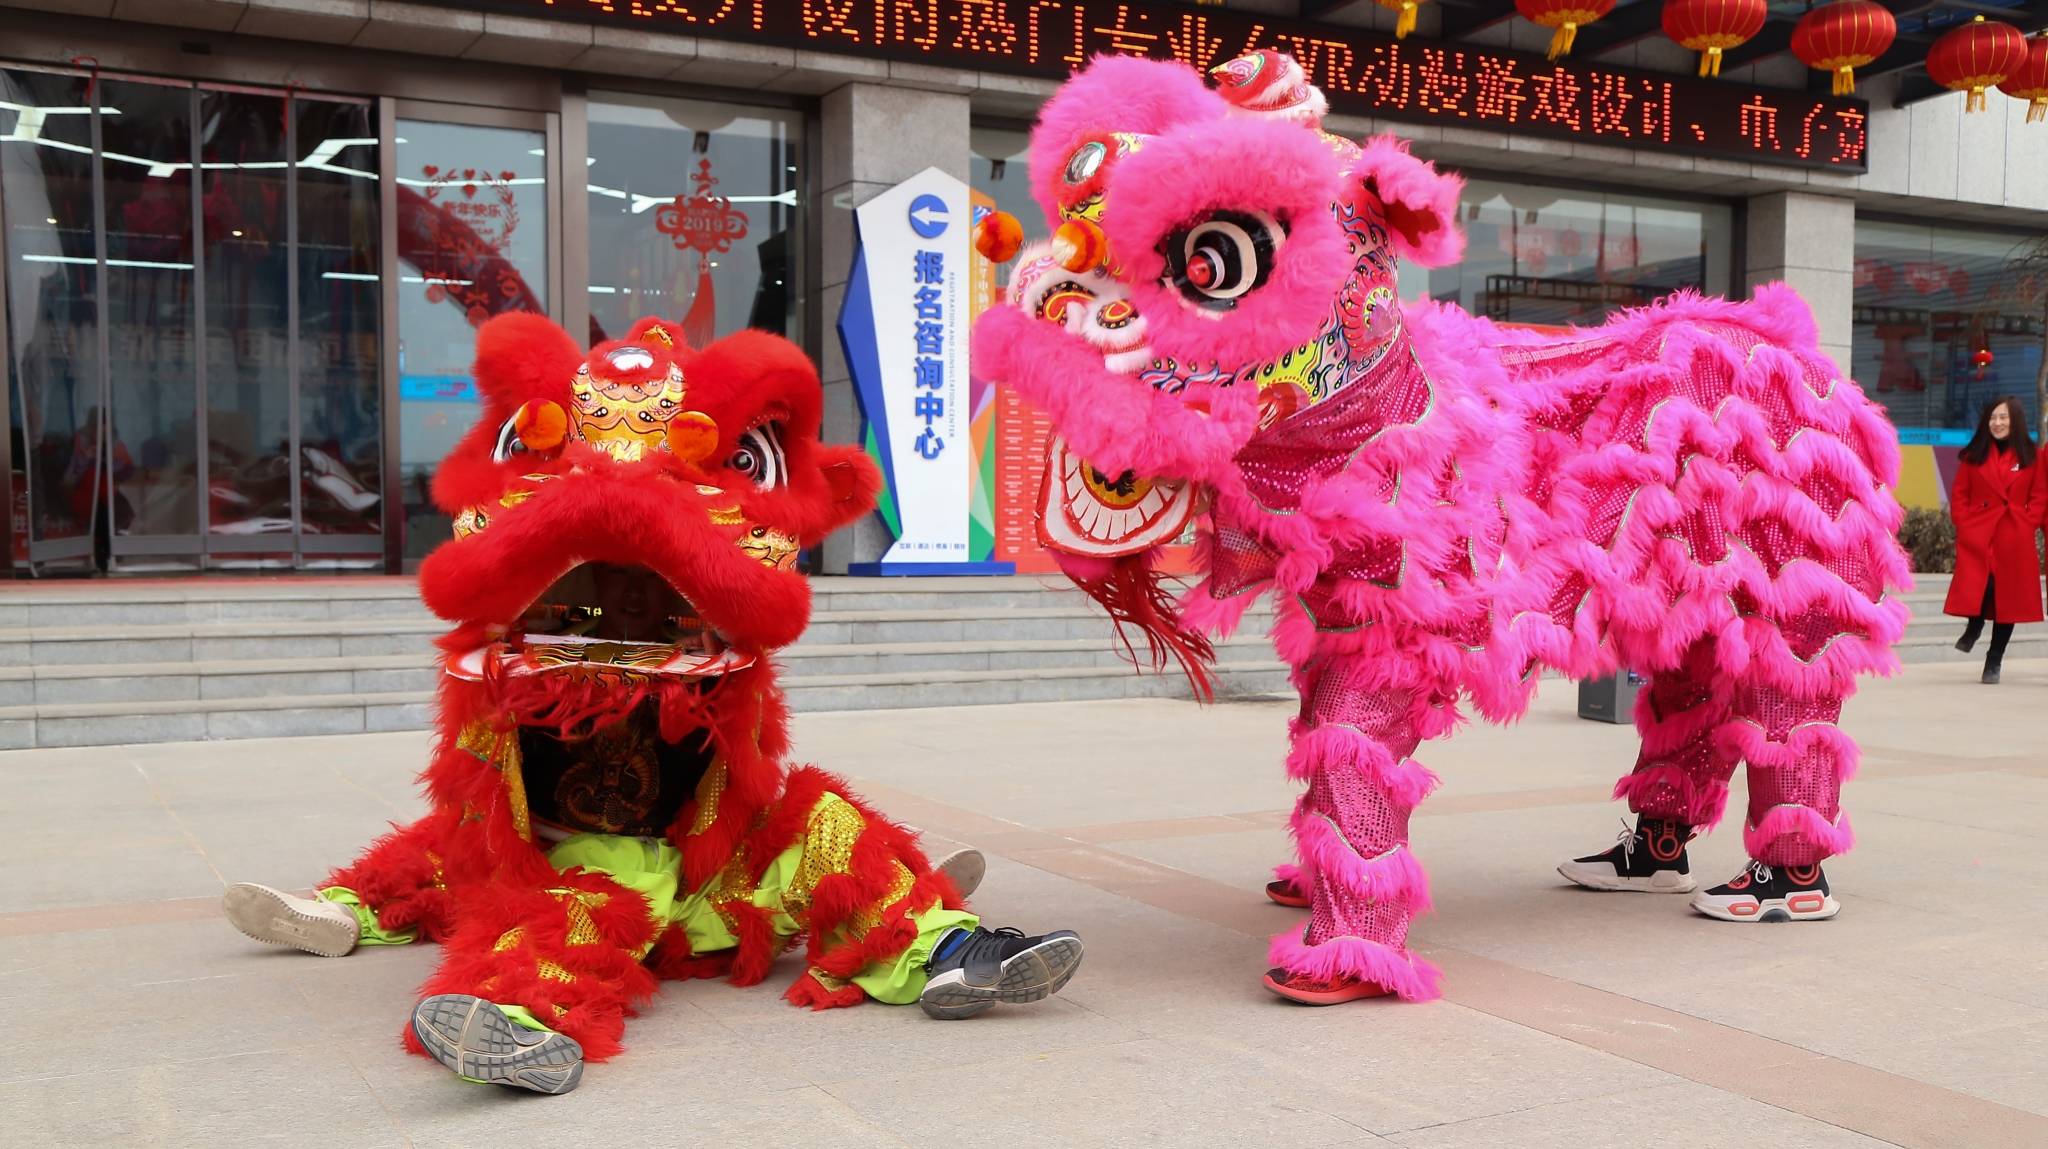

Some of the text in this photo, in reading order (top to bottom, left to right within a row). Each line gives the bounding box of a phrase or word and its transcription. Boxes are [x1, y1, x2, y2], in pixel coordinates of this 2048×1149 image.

[683, 217, 723, 232] 2019
[913, 250, 945, 461] 报名咨询中心
